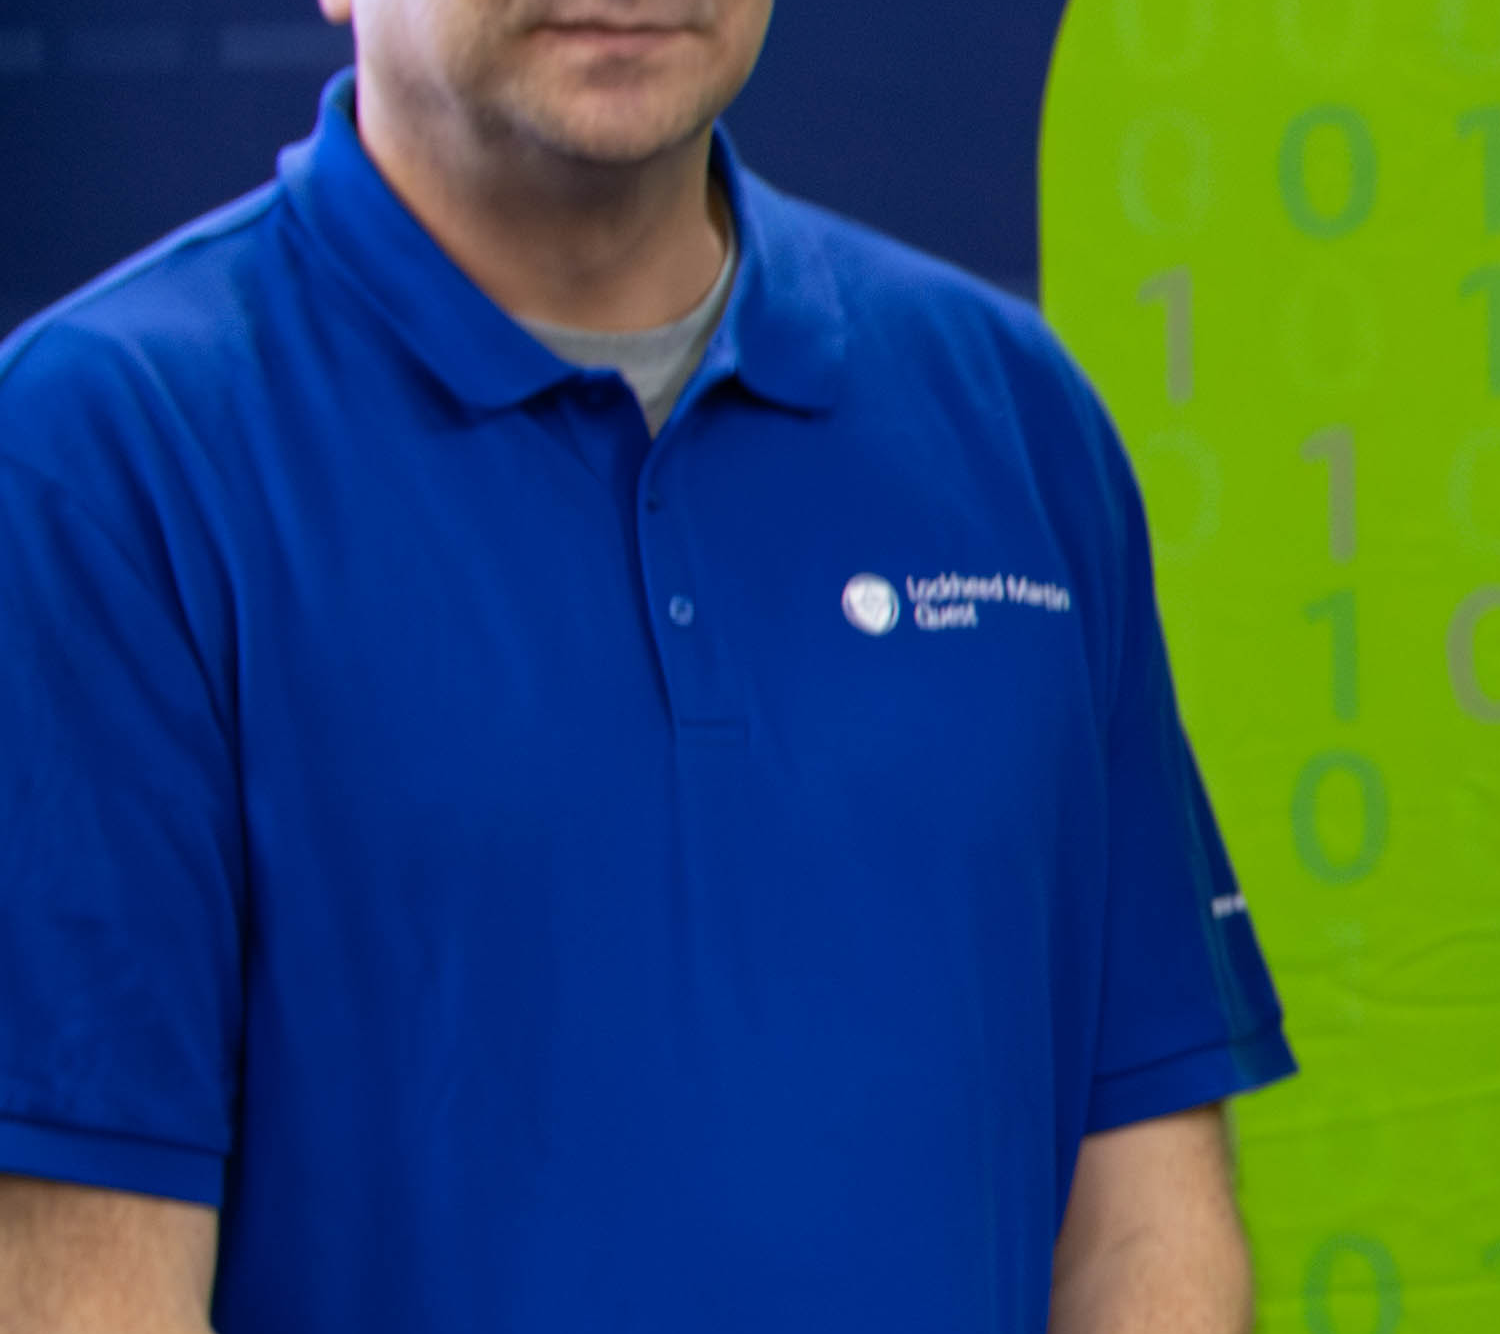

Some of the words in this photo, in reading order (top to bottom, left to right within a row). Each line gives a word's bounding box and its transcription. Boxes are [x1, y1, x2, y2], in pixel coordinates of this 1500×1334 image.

[1278, 102, 1379, 239] 0
[1137, 264, 1195, 405] 1
[1300, 423, 1356, 563] 1
[906, 571, 1004, 604] Lockheed
[1006, 573, 1071, 612] Martin
[1302, 585, 1360, 723] 1
[1290, 747, 1389, 886] 0
